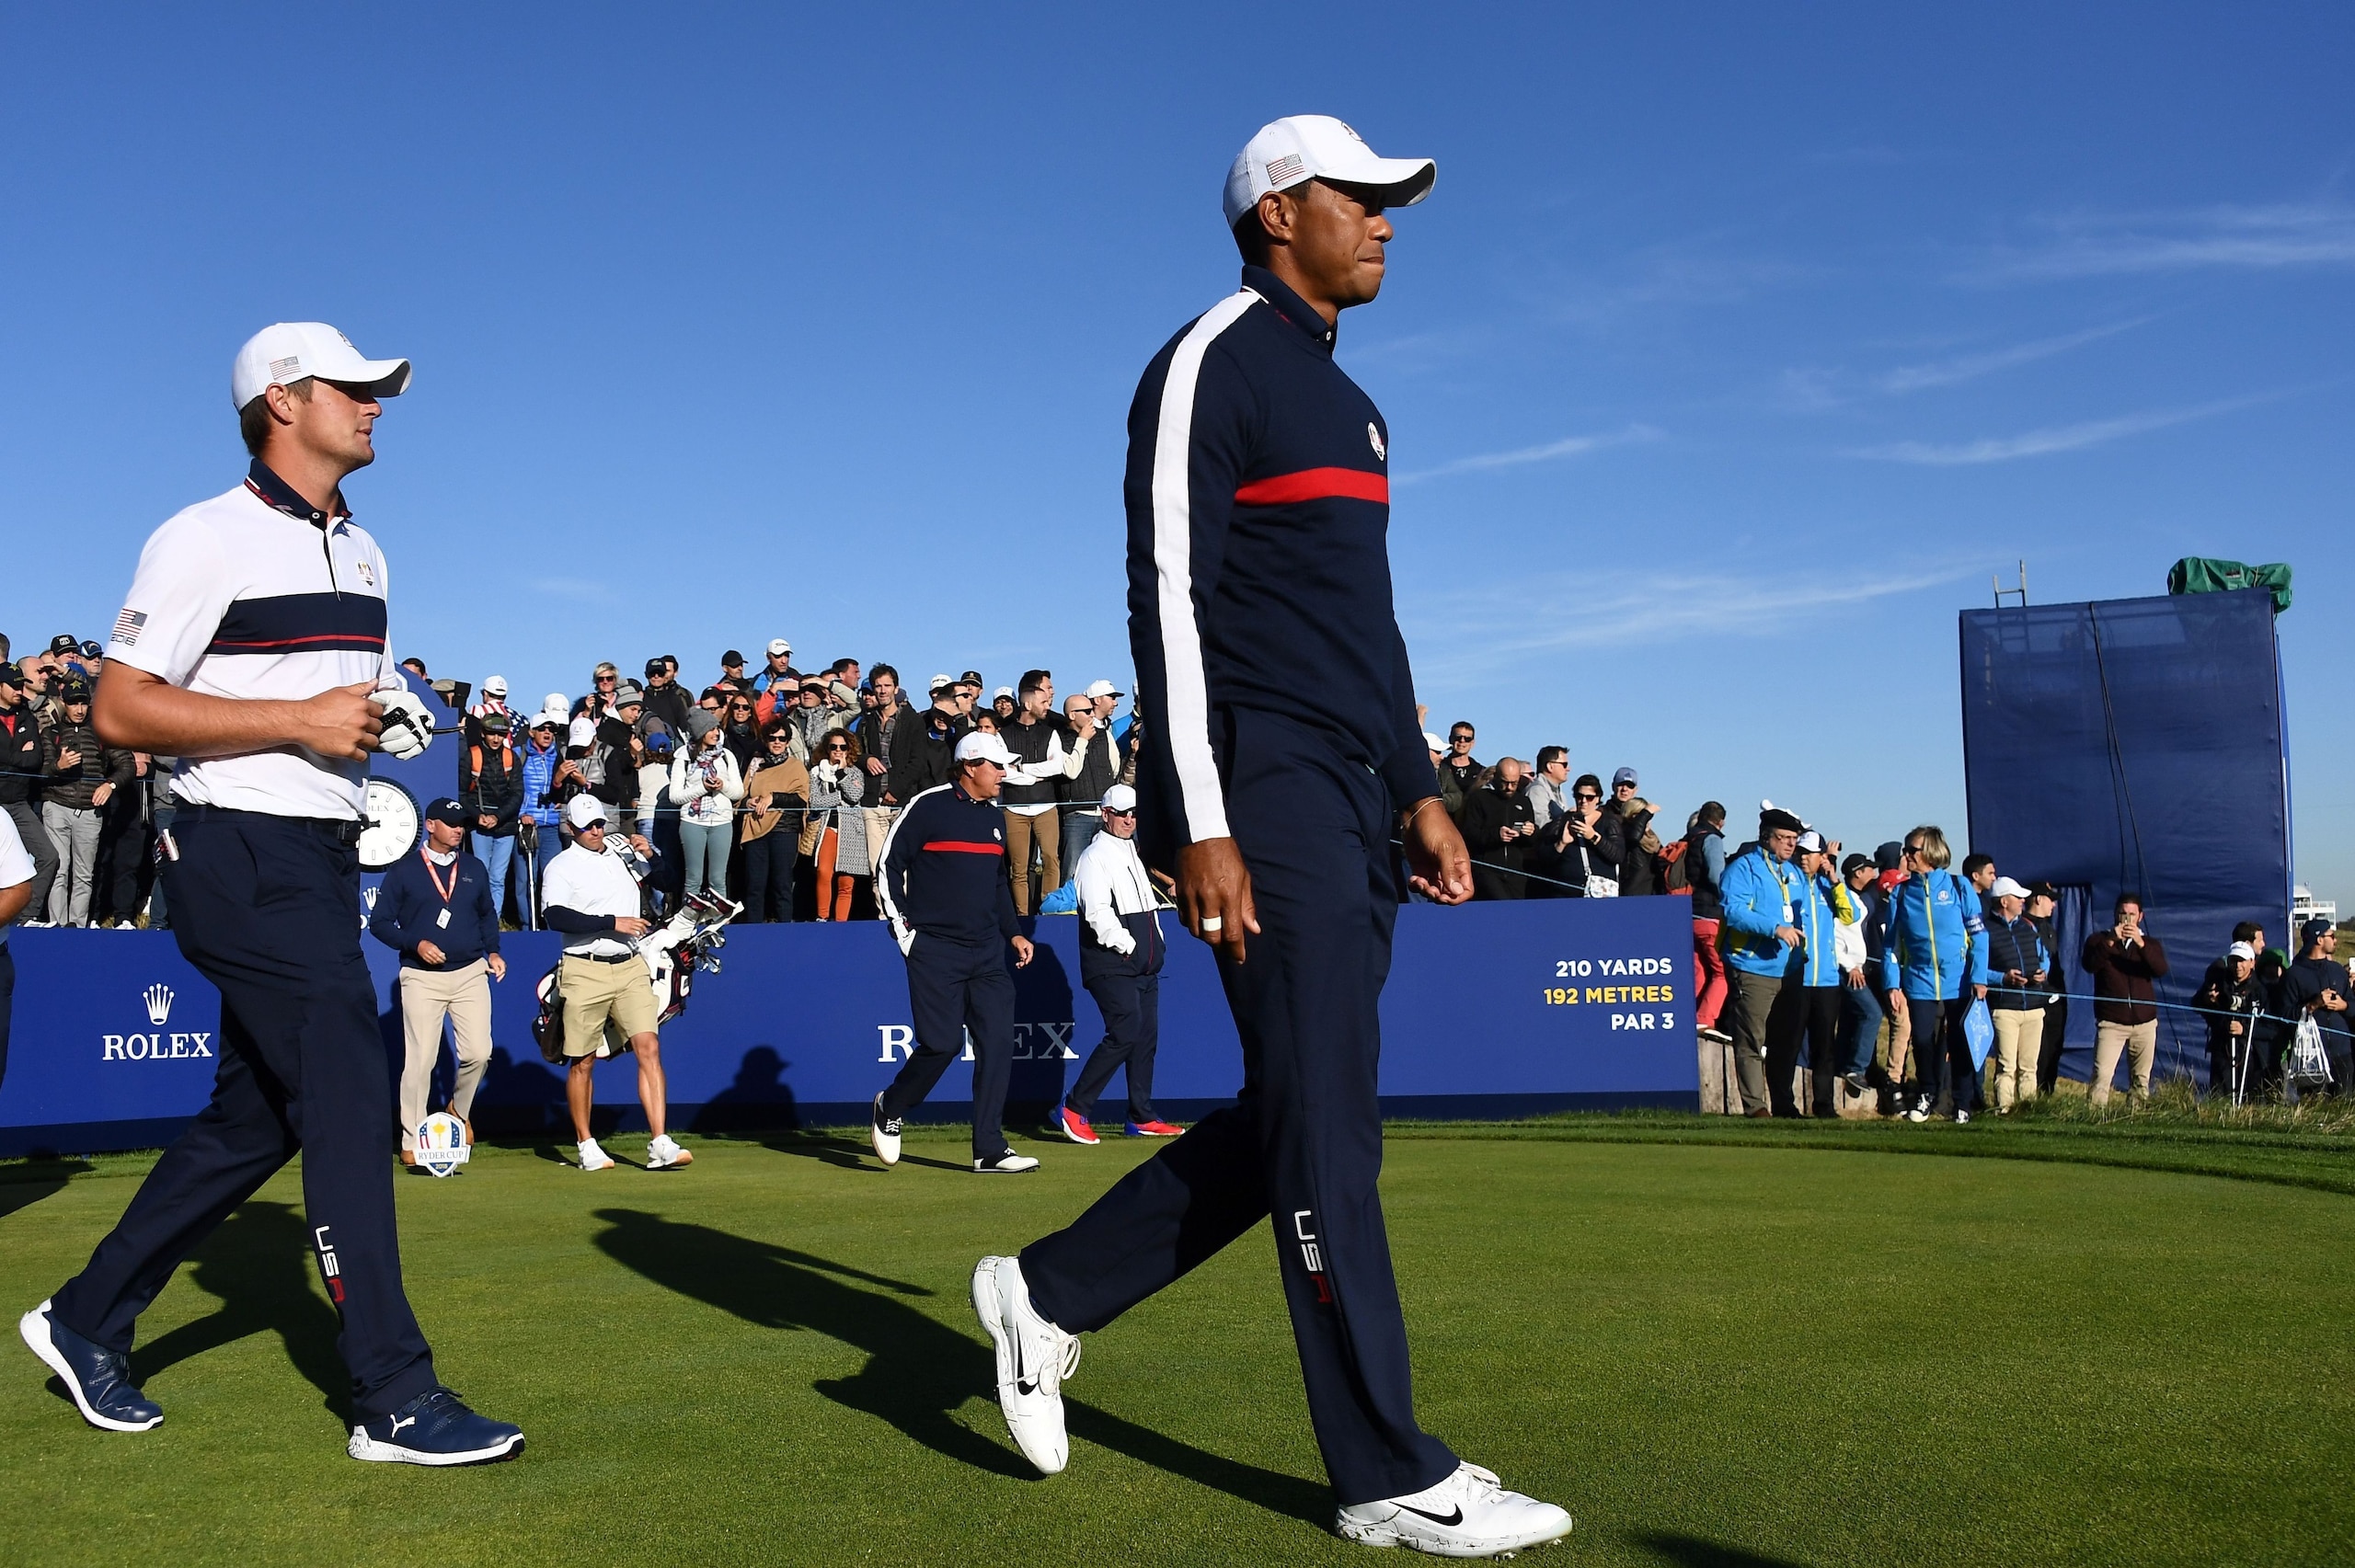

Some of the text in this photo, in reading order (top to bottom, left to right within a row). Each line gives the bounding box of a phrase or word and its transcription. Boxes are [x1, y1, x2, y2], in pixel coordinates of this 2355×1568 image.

[367, 804, 390, 812] LEX
[1556, 957, 1673, 978] 210 YARDS
[1544, 985, 1674, 1005] 192 METRES
[1611, 1012, 1674, 1031] PAR 3
[102, 1032, 213, 1061] ROLEX
[877, 1022, 1080, 1063] REX
[419, 1150, 464, 1161] RYDER CUP
[315, 1225, 346, 1303] USA
[1294, 1209, 1333, 1304] USA
